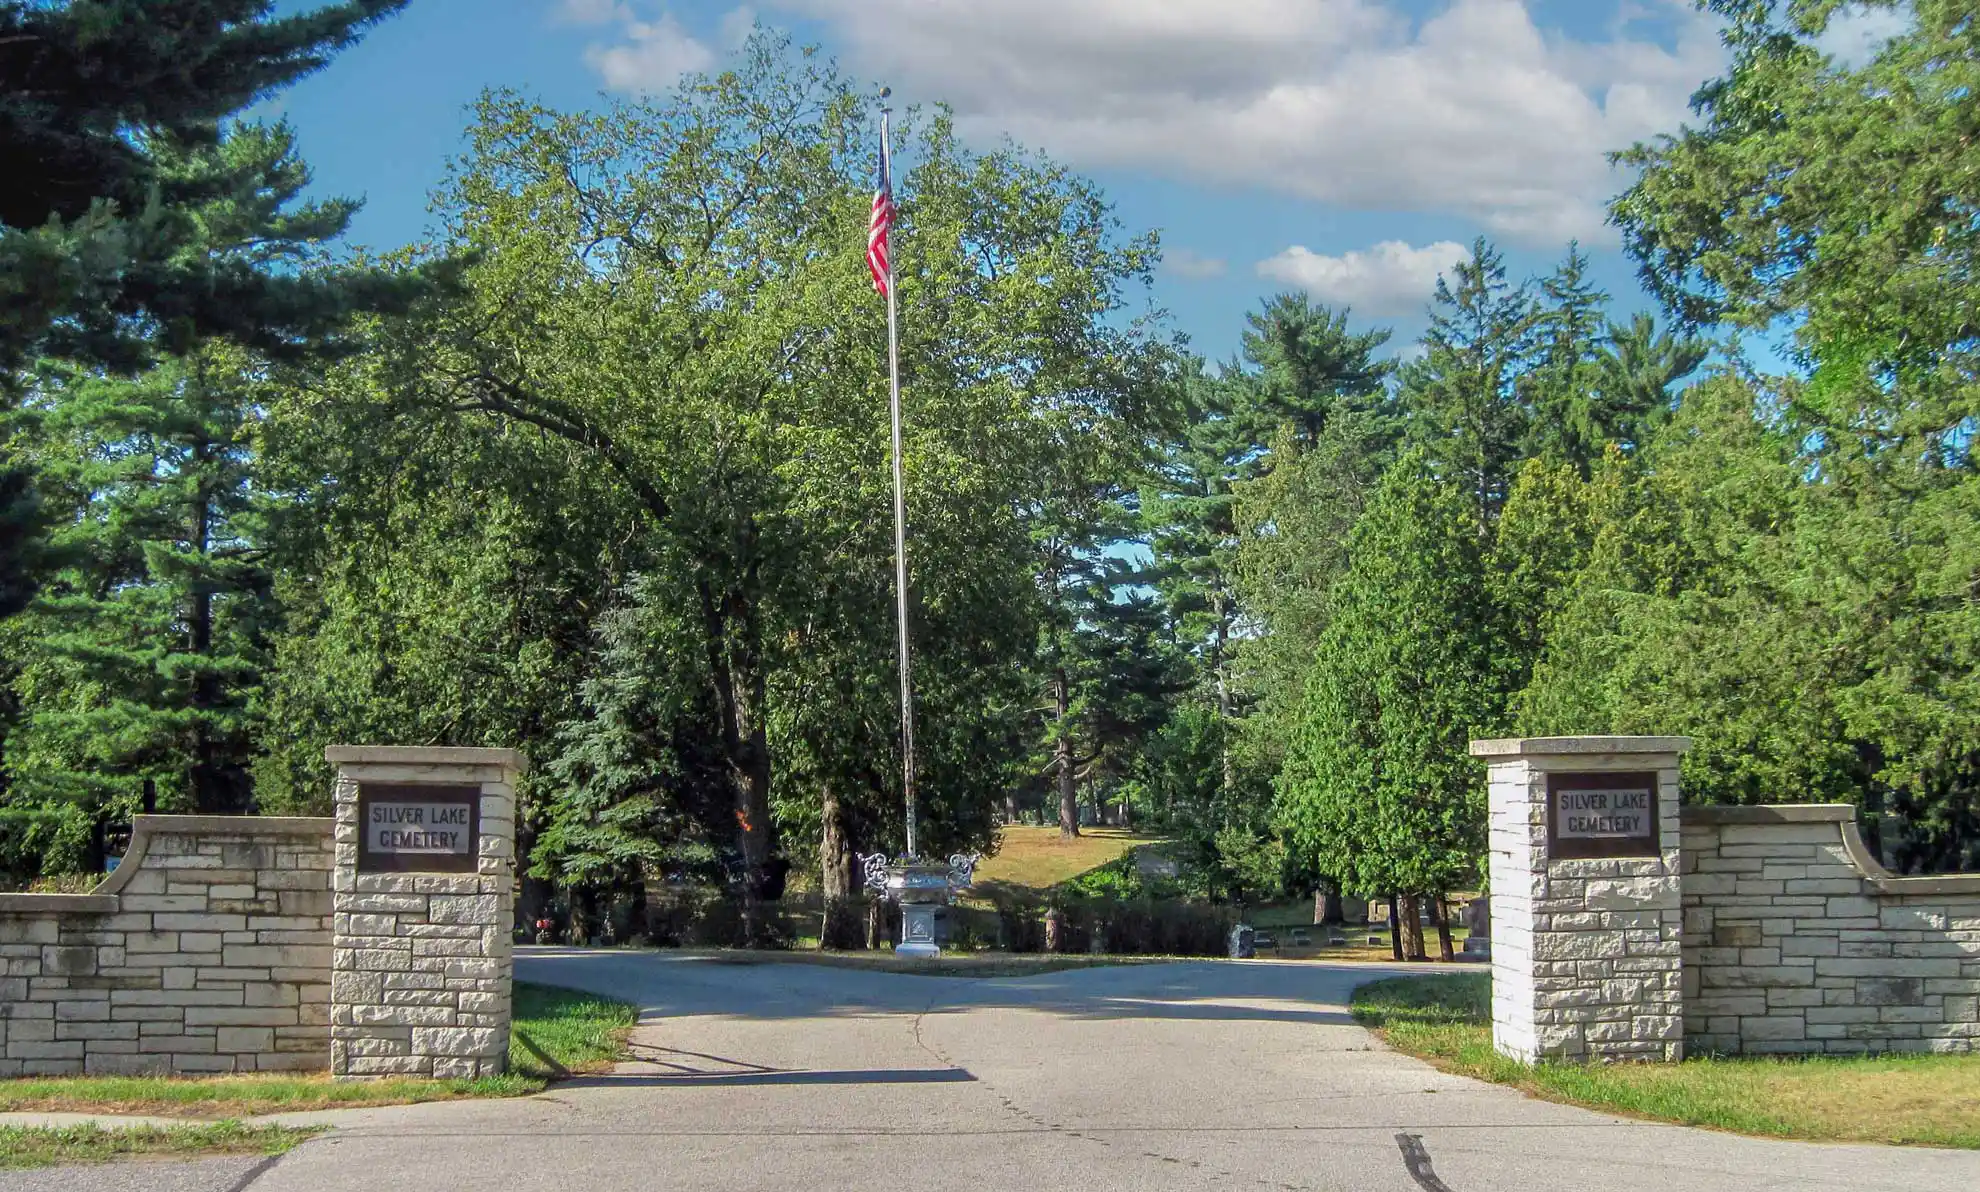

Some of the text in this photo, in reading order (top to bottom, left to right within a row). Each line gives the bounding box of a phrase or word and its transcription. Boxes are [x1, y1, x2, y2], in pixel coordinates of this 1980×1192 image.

[1561, 793, 1648, 810] SILVER LAKE
[373, 807, 468, 825] SILVER LAKE
[1568, 816, 1640, 833] CEMETERY
[380, 831, 459, 849] CEMETERY
